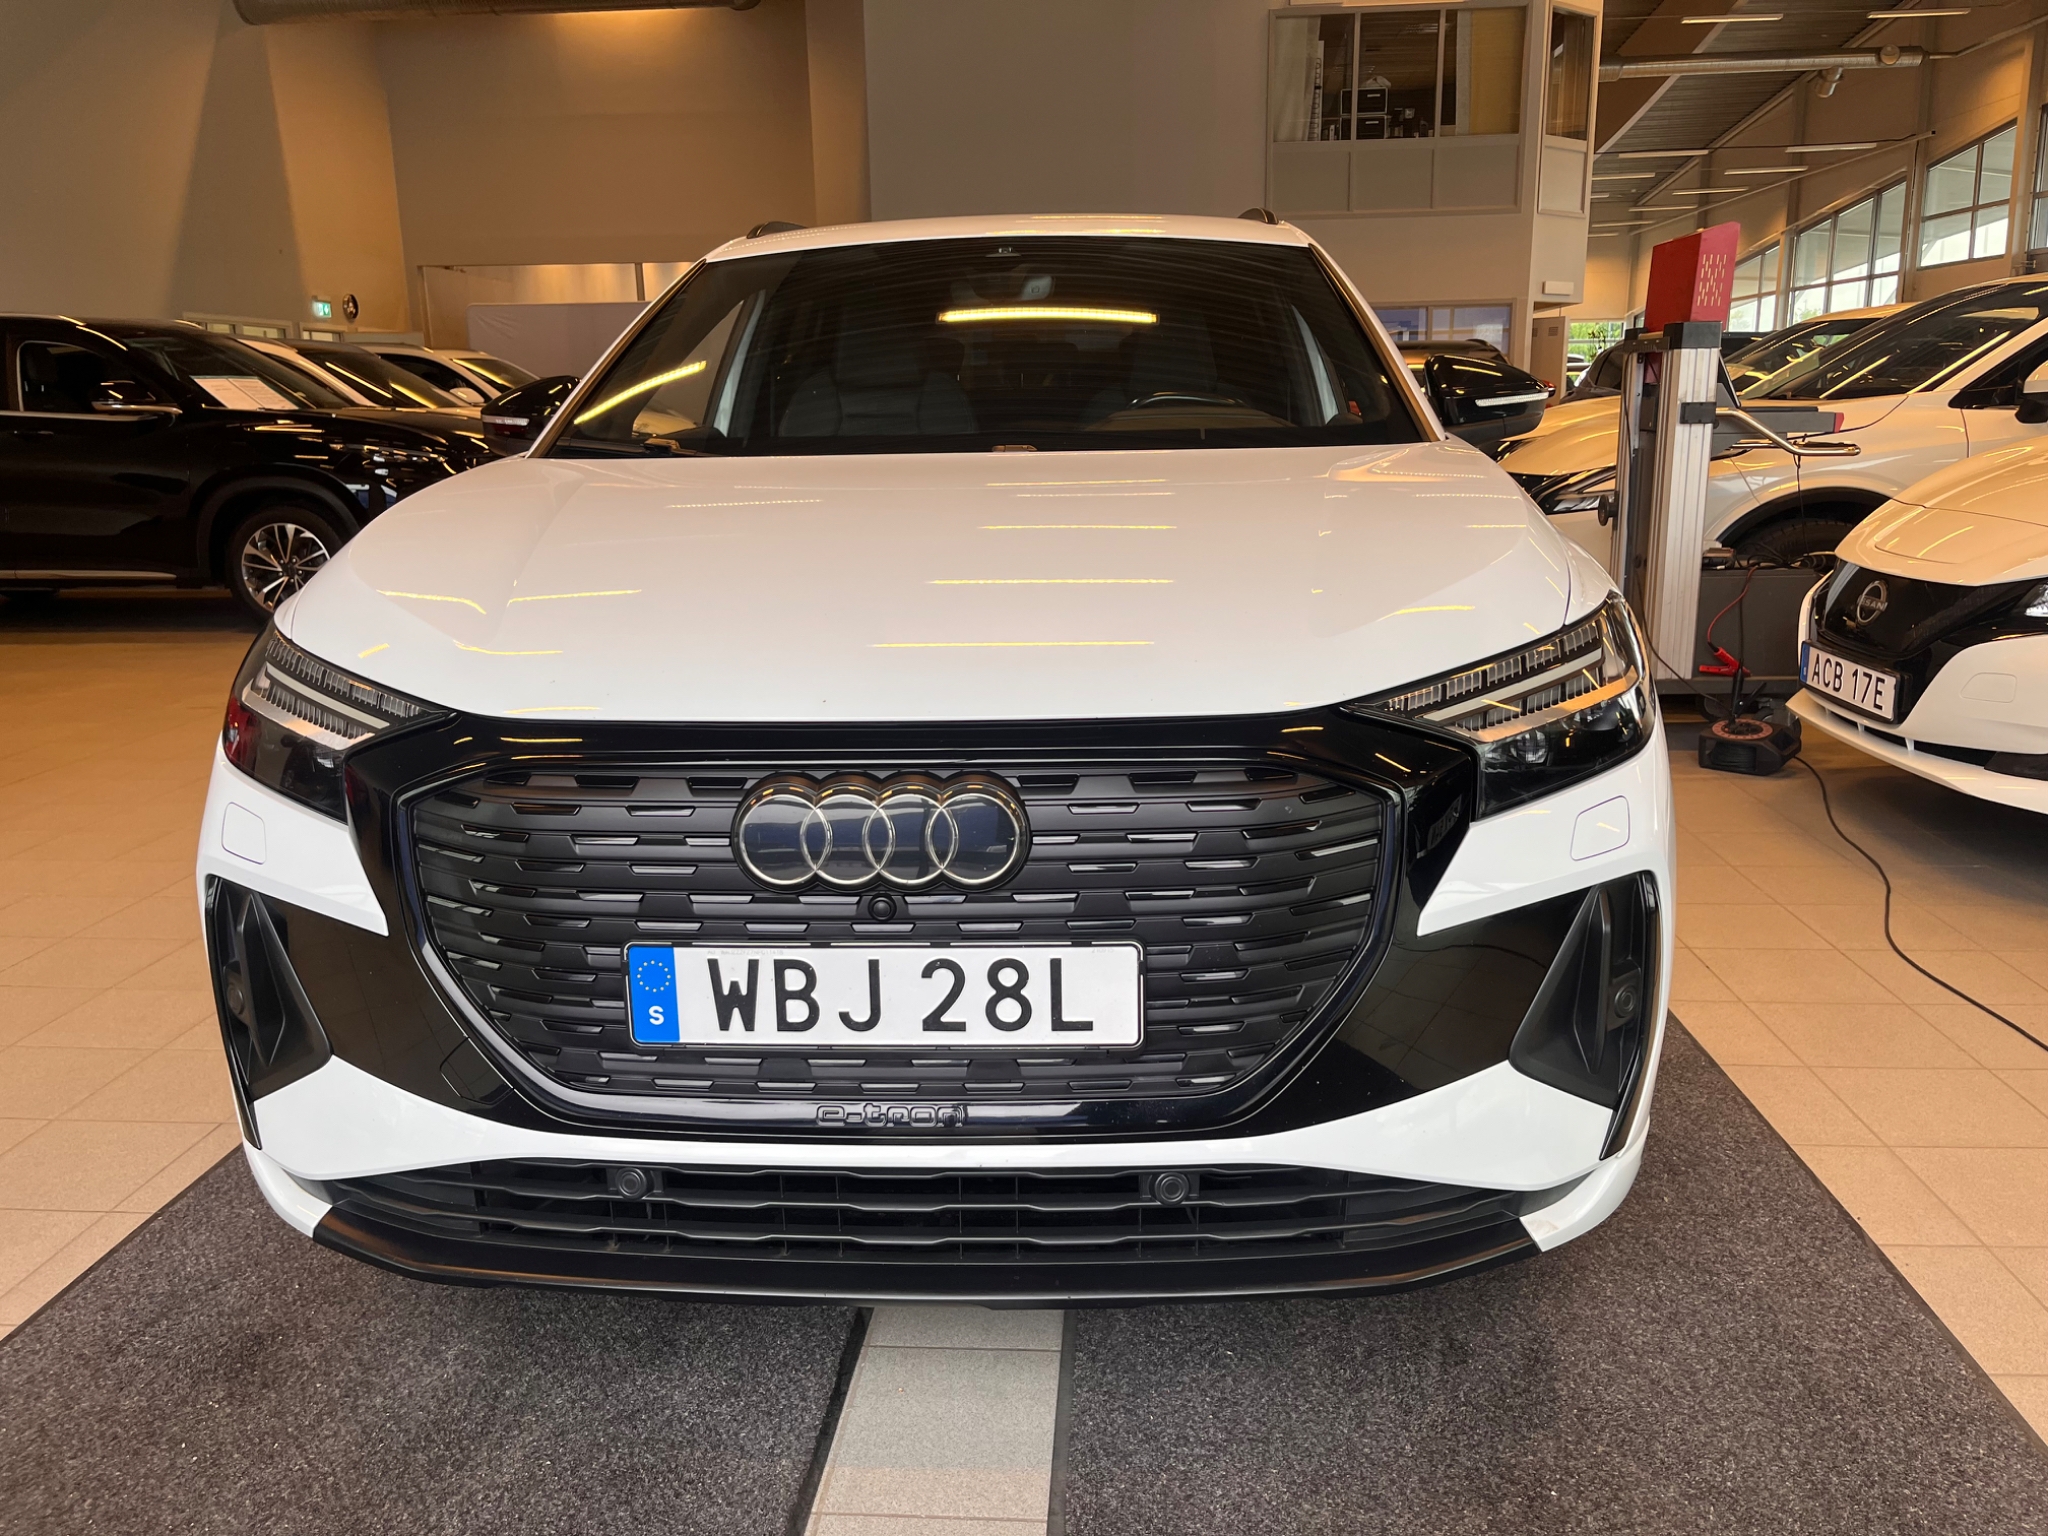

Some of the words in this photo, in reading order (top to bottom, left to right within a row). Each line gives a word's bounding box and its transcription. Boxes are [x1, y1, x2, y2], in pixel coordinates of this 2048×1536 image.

[1858, 596, 1887, 611] SSAN
[1811, 653, 1843, 692] ACB
[1852, 668, 1886, 711] 17E
[707, 958, 881, 1032] WBJ
[921, 957, 1094, 1032] 28L
[648, 1005, 665, 1025] S
[816, 1102, 968, 1128] e-tron
